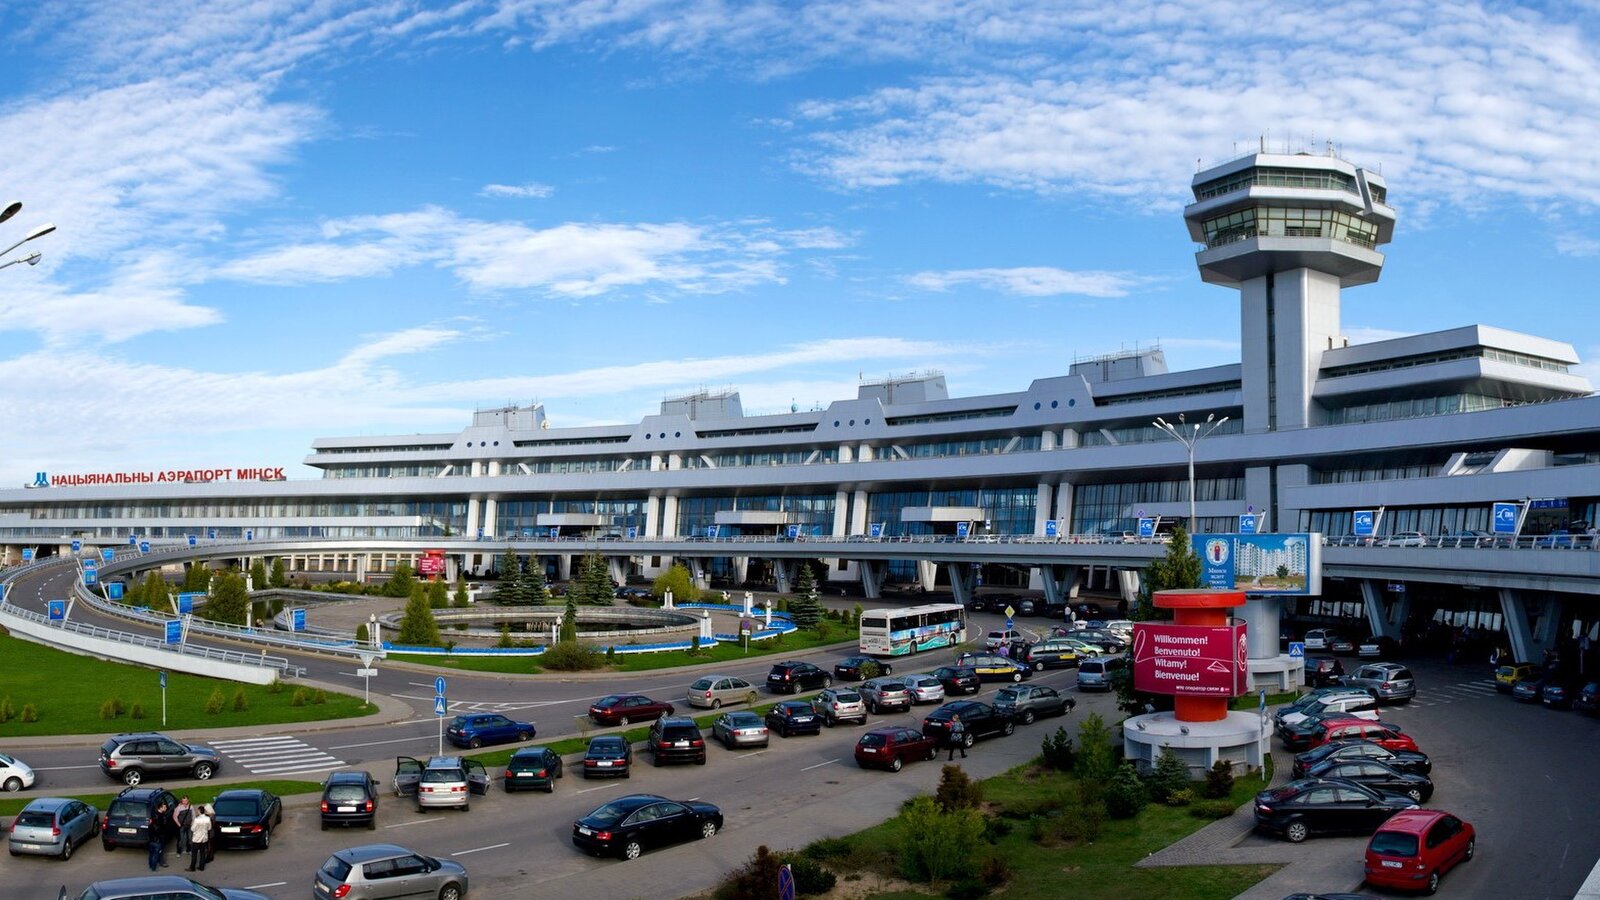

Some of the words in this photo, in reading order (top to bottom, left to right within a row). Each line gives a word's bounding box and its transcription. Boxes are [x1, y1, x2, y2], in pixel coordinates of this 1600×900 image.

[52, 472, 154, 486] НАЦЫЯНАЛЬНЫ
[157, 469, 232, 482] АЭРАПОРТ
[237, 467, 284, 480] МІНСК
[1154, 634, 1208, 645] Willkommen!
[1154, 646, 1201, 657] Benvenuto!
[1154, 658, 1187, 670] Witamy!
[1155, 670, 1199, 681] Bienvenue!
